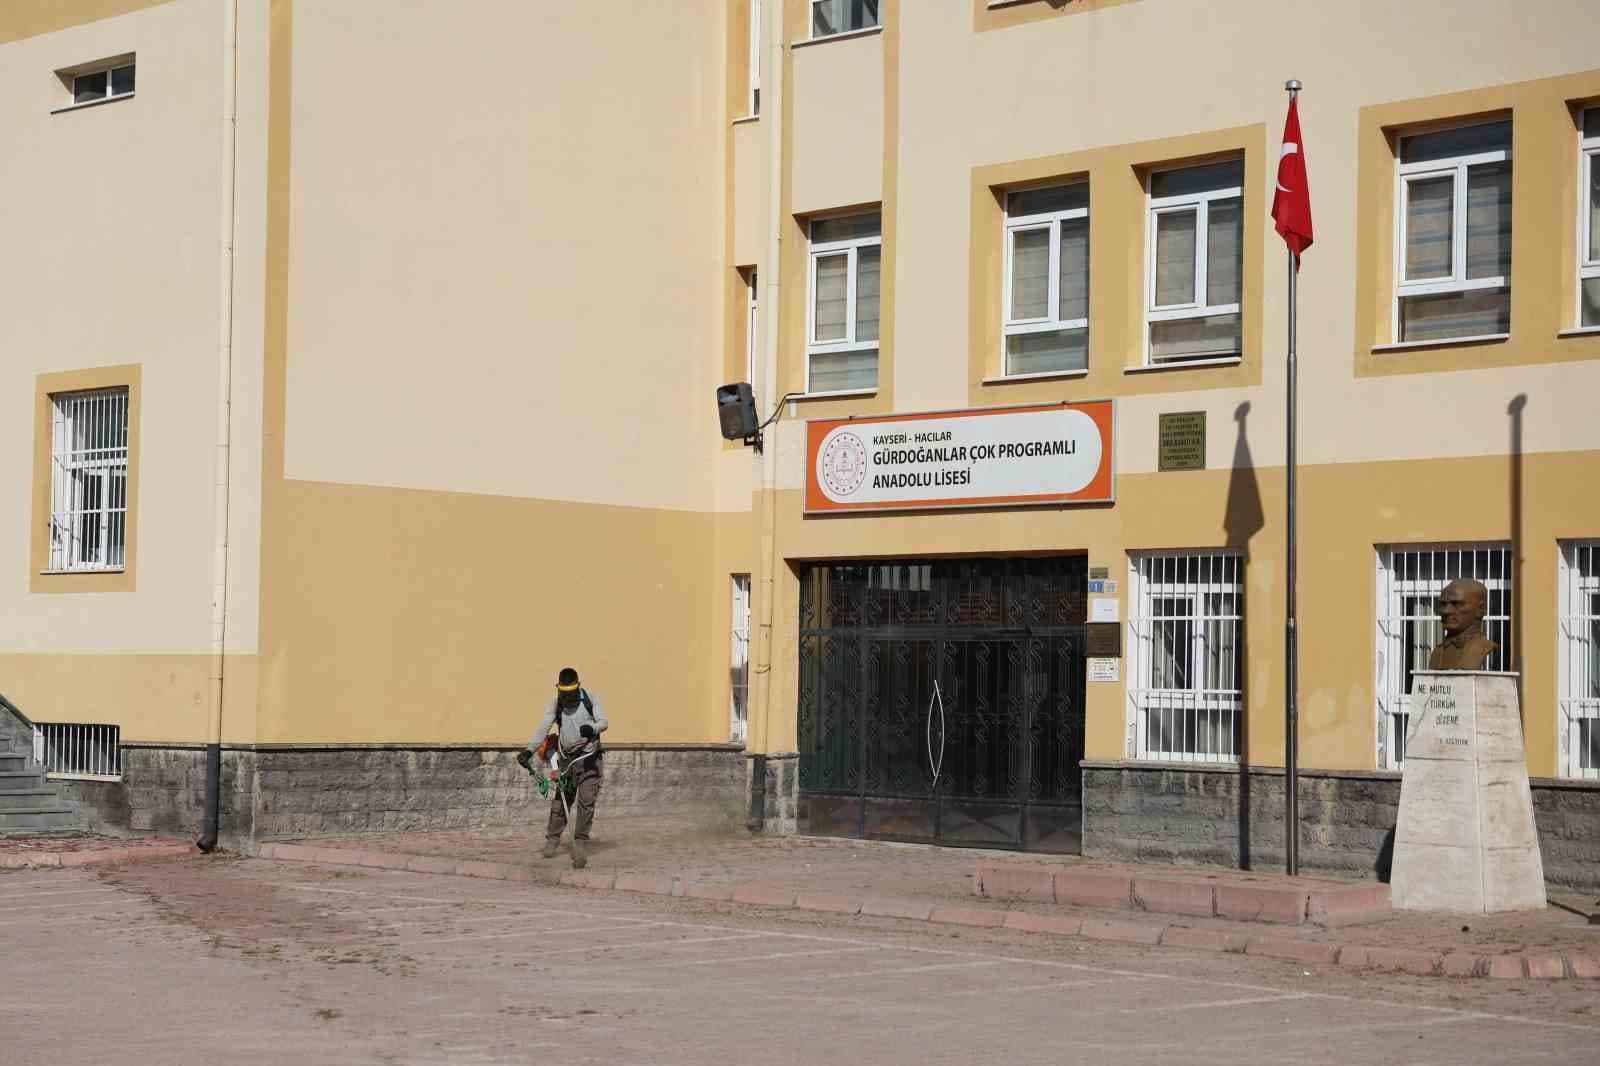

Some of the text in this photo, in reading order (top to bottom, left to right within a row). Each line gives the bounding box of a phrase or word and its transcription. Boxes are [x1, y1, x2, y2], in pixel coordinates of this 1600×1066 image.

[874, 432, 907, 445] KAYSERİ
[915, 432, 952, 443] HACILAR
[873, 440, 1076, 465] GÜRDOĞANLAR ÇOK PROGRAMLI
[873, 468, 970, 488] ANADOLU LİSESİ
[1430, 685, 1451, 694] MUTLU
